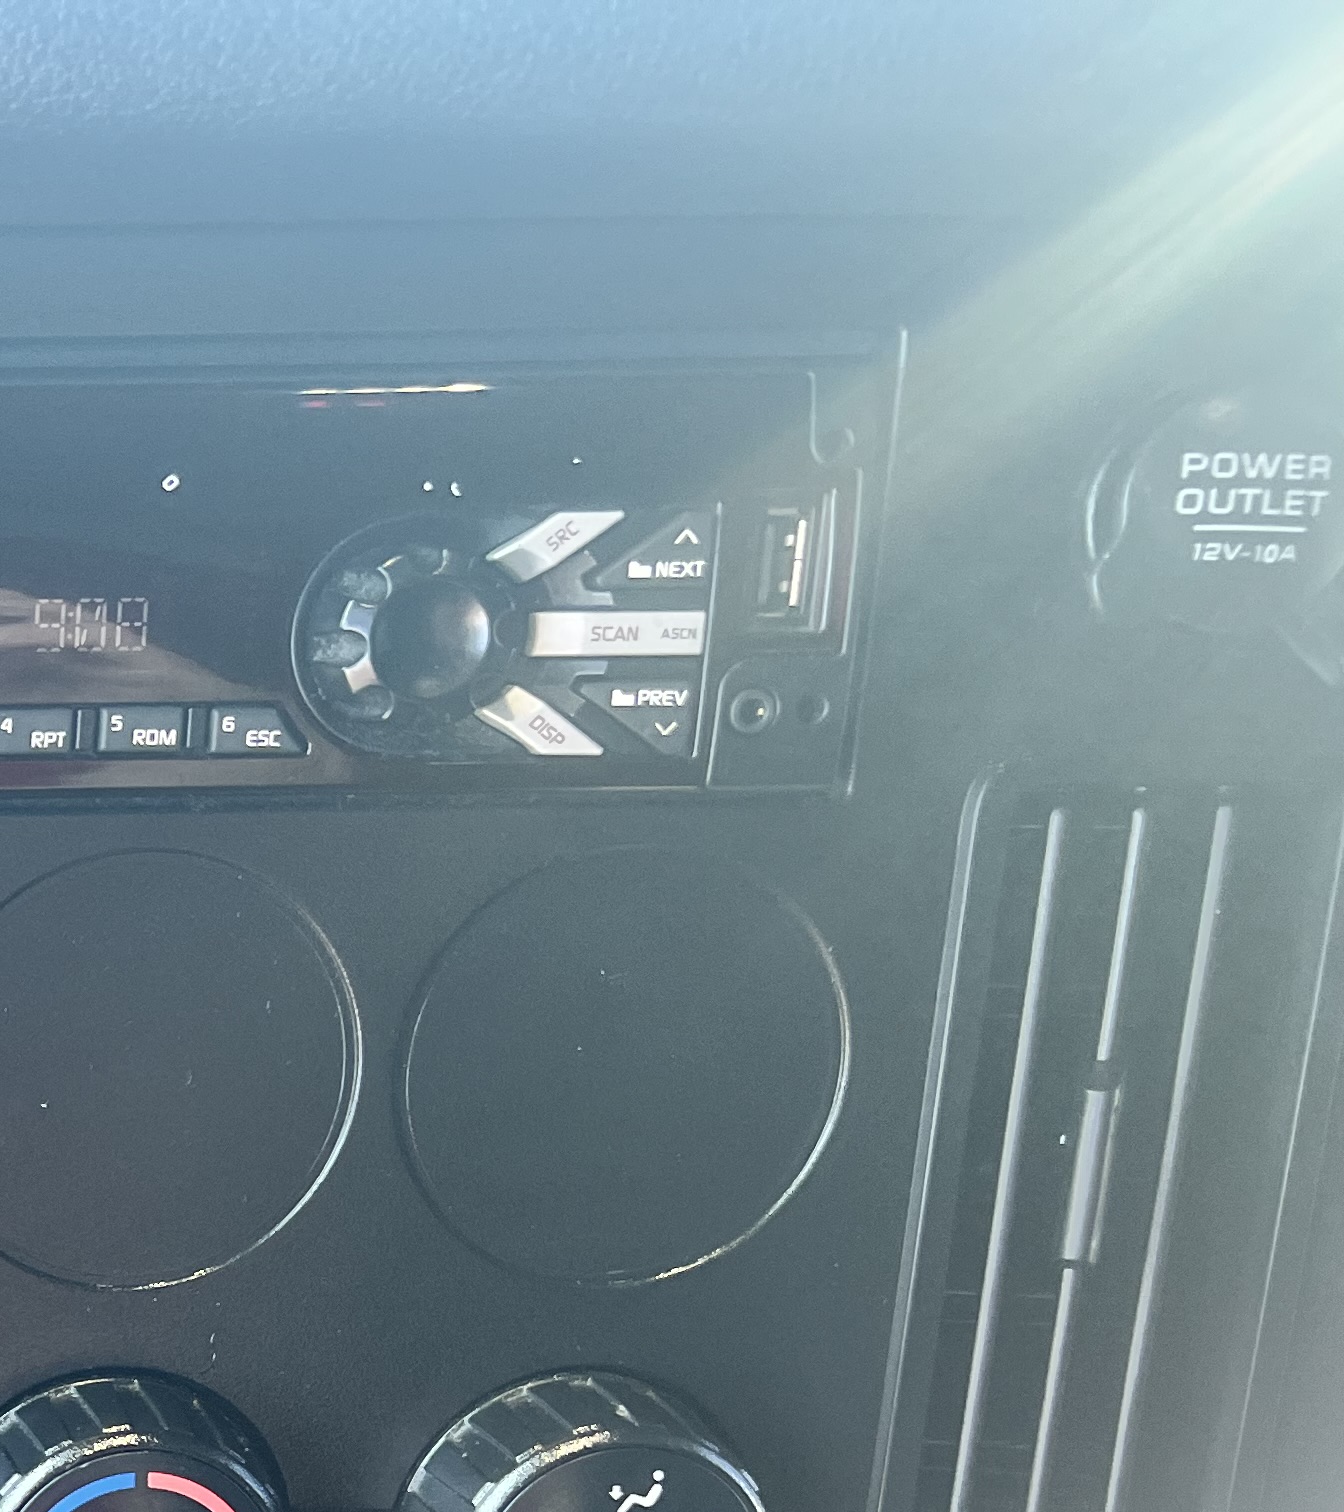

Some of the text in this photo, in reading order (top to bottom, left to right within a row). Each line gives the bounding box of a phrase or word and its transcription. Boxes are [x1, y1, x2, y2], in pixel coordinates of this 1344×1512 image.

[1180, 452, 1332, 480] POWER
[1175, 488, 1330, 516] OUTLET
[546, 520, 580, 552] SRC
[1192, 542, 1296, 563] 12V-10A
[655, 560, 707, 578] NEXT
[591, 626, 639, 642] SCAN
[638, 690, 690, 707] PREV
[0, 718, 67, 749] 4 RPT
[111, 716, 177, 746] 5 RDM
[222, 716, 281, 748] 6 ESC
[527, 715, 565, 747] DISP
